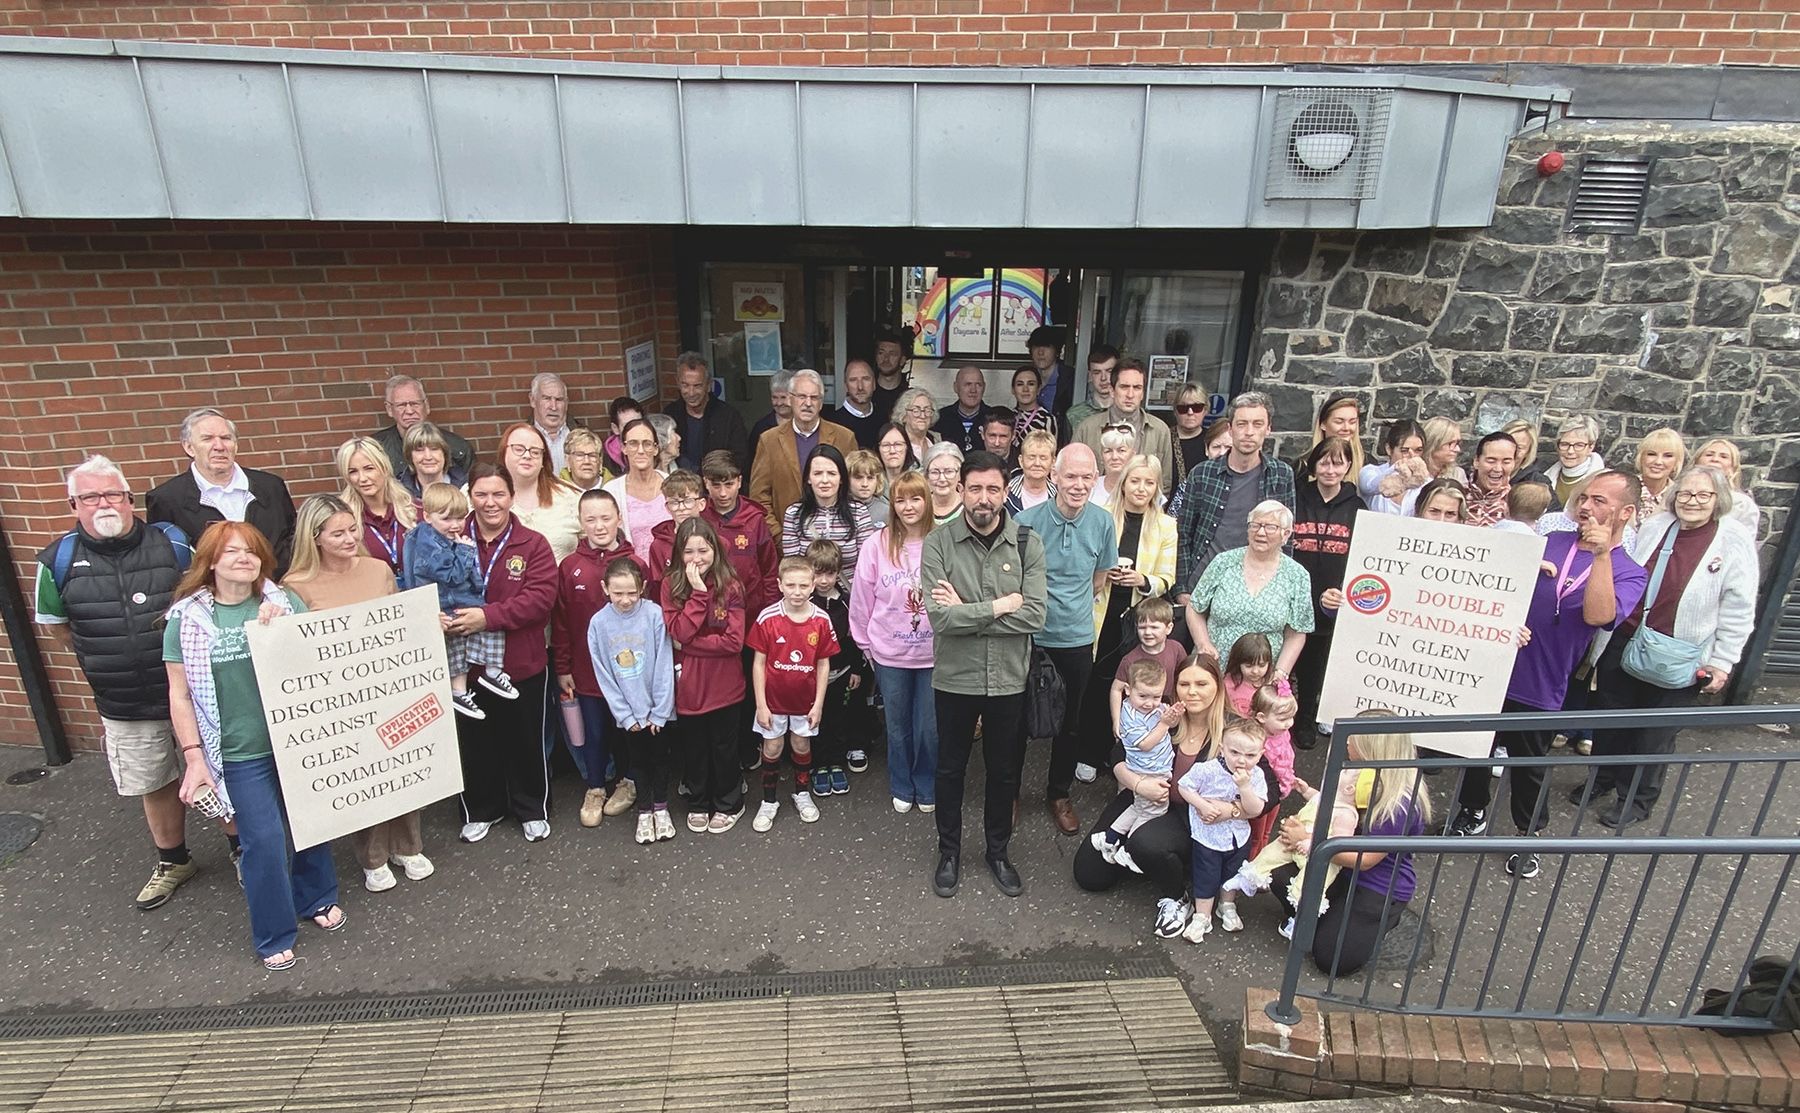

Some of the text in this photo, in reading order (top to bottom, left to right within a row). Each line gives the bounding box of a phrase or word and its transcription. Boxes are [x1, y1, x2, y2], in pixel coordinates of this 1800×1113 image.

[953, 327, 987, 337] Daycare &
[1000, 328, 1016, 336] After
[1396, 536, 1491, 563] BELFAST
[1363, 555, 1517, 593] CITY COUNCIL
[1416, 589, 1505, 617] DOUBLE
[297, 604, 405, 639] WHY ARE
[1386, 609, 1512, 645] STANDARDS
[317, 627, 407, 662] BELFAST
[1377, 631, 1470, 662] IN GLEN
[281, 647, 432, 695] CITY COUNCIL
[1355, 649, 1485, 689] COMMUNITY
[269, 667, 445, 725] DISCRIMINATING
[1363, 674, 1459, 708] COMPLEX
[284, 711, 379, 749] AGAINST
[381, 696, 435, 737] APPLICATION
[389, 708, 439, 744] DENIED
[301, 742, 361, 770] GLEN
[311, 743, 436, 793] COMMUNITY
[332, 766, 432, 812] COMPLEX?
